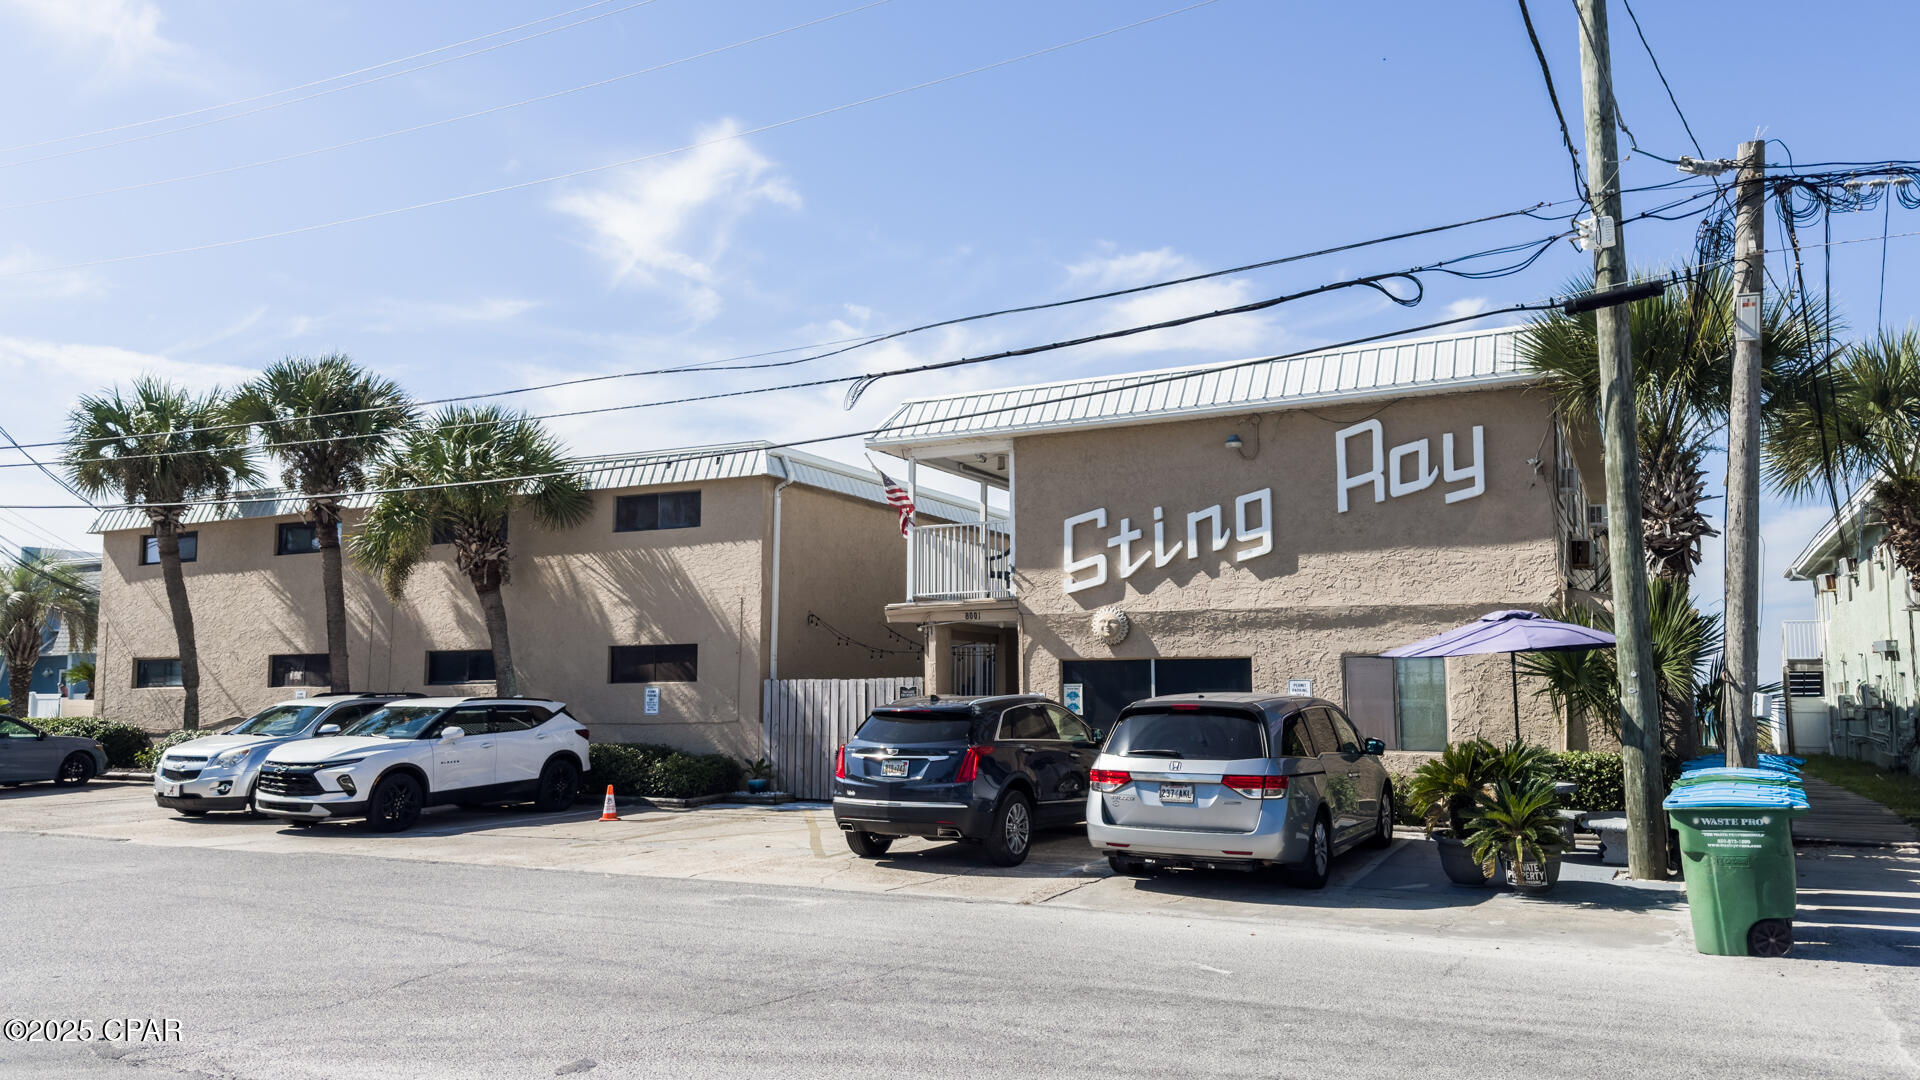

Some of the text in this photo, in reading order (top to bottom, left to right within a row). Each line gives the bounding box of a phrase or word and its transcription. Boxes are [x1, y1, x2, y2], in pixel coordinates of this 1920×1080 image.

[1064, 419, 1486, 593] Sting Ray
[1701, 817, 1764, 826] WASTE PRO
